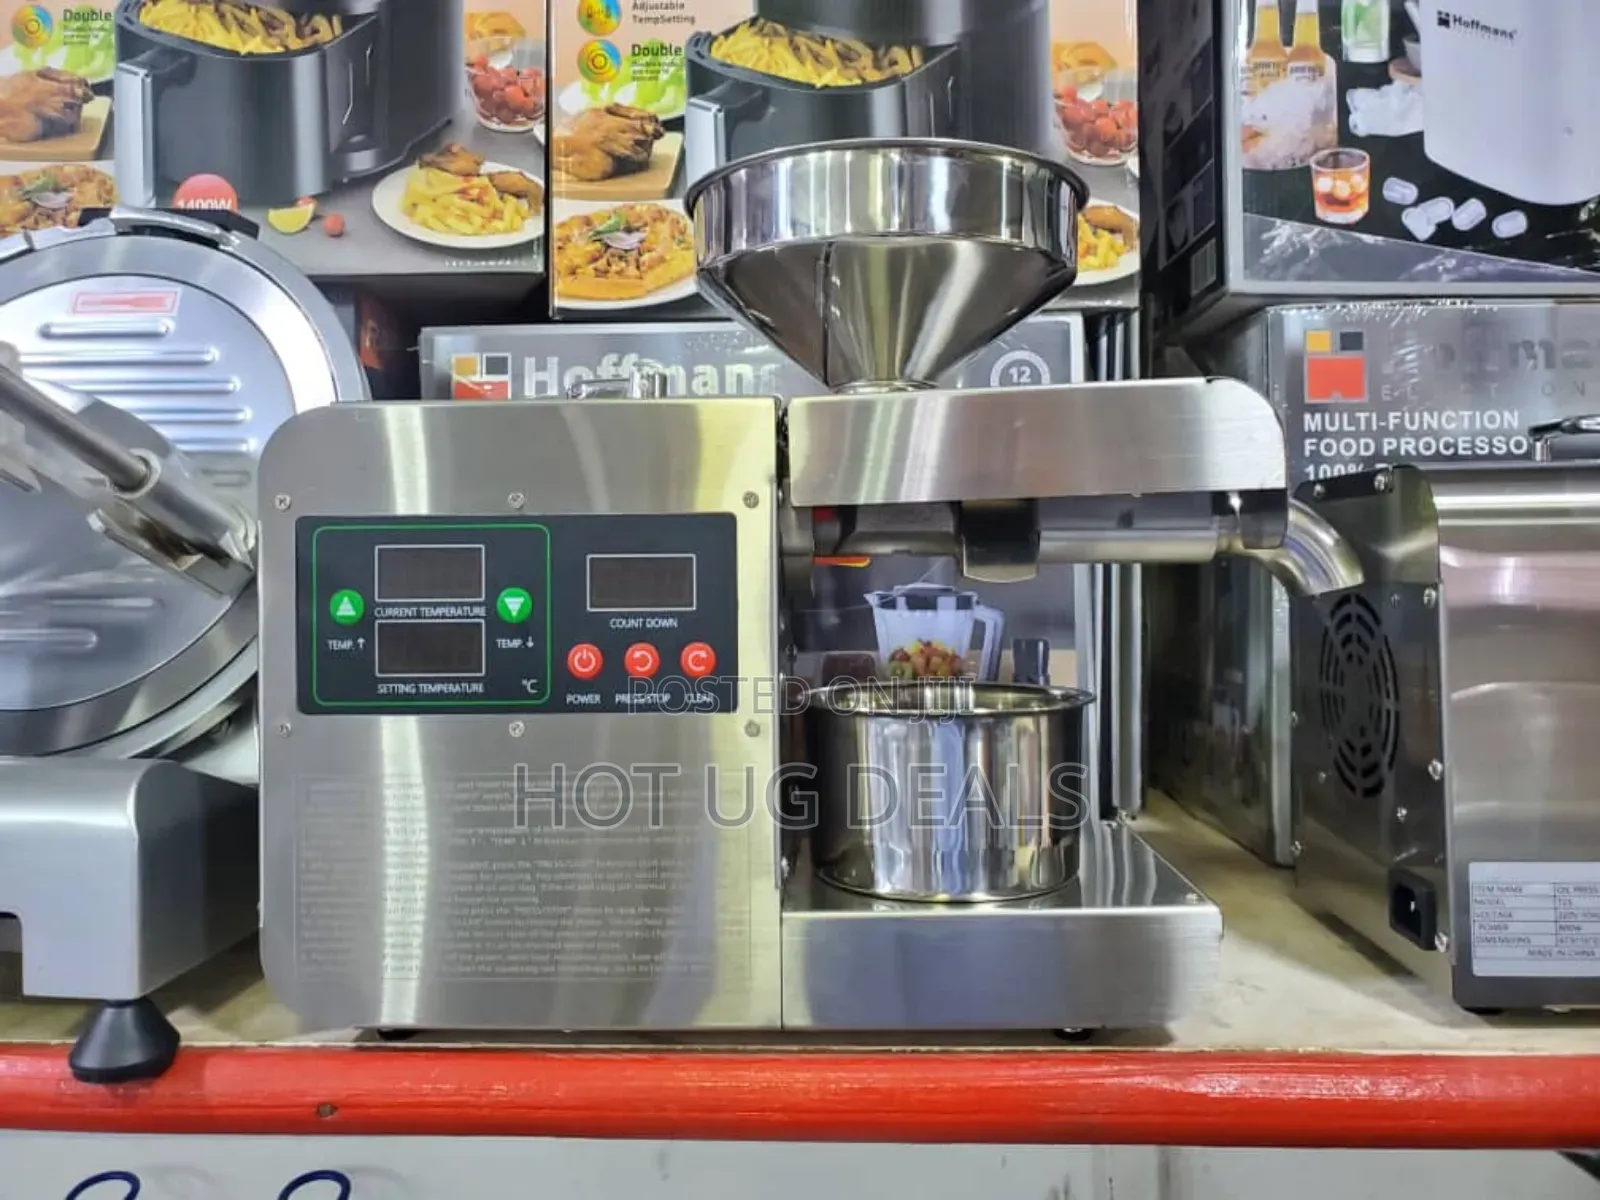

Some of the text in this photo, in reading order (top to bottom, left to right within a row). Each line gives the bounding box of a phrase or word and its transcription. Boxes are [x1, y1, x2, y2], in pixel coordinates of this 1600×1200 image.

[632, 1, 685, 12] Adjustable
[63, 8, 113, 21] Double
[632, 14, 696, 25] TempSetting
[631, 43, 683, 57] Double
[1008, 366, 1032, 383] 12
[1304, 410, 1520, 433] MULTI-FUNCTION
[1304, 436, 1532, 457] FOOD PROCESSO
[374, 606, 487, 617] CURRENT TEMPERATURE
[609, 618, 678, 628] COUNT DOWN
[376, 683, 484, 694] SETTING TEMPERATURE
[565, 693, 601, 704] POWER
